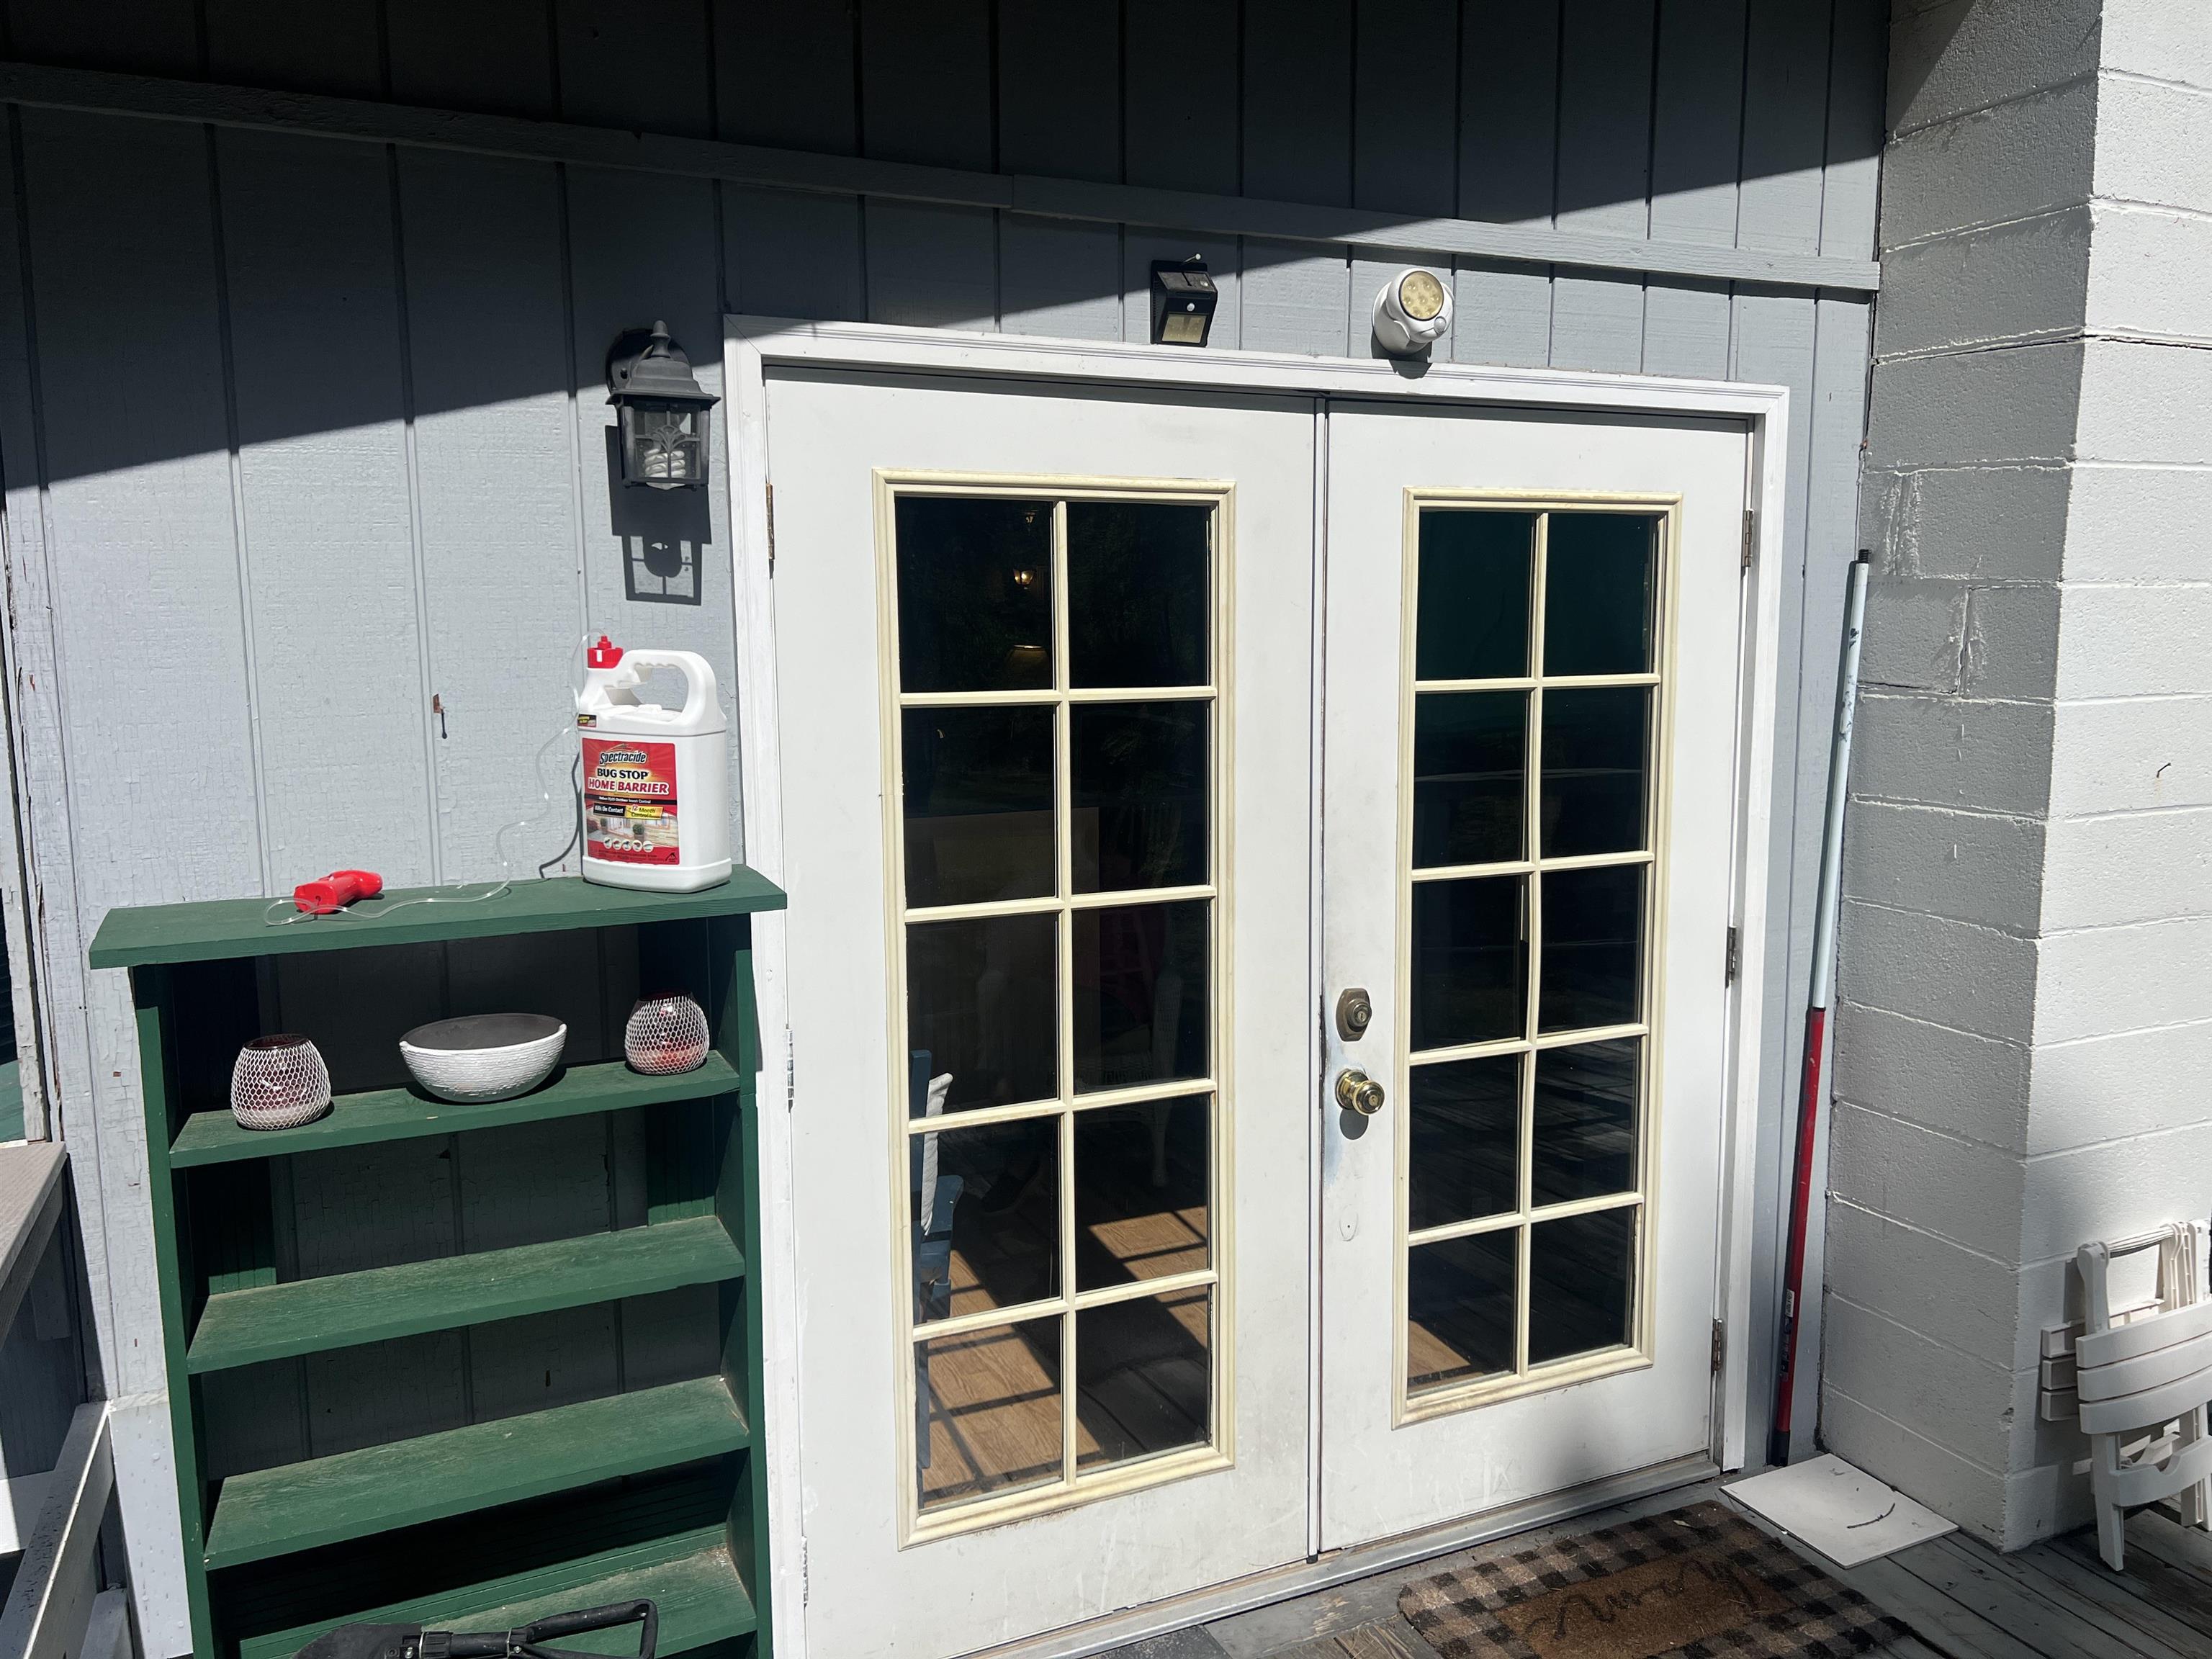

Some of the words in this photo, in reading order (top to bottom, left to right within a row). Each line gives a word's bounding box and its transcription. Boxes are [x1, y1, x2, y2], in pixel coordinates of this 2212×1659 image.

[599, 751, 647, 765] Spectracide
[597, 768, 617, 778] BUG
[619, 770, 649, 780] STOP
[589, 778, 616, 791] HOME
[618, 781, 669, 793] BARRIER
